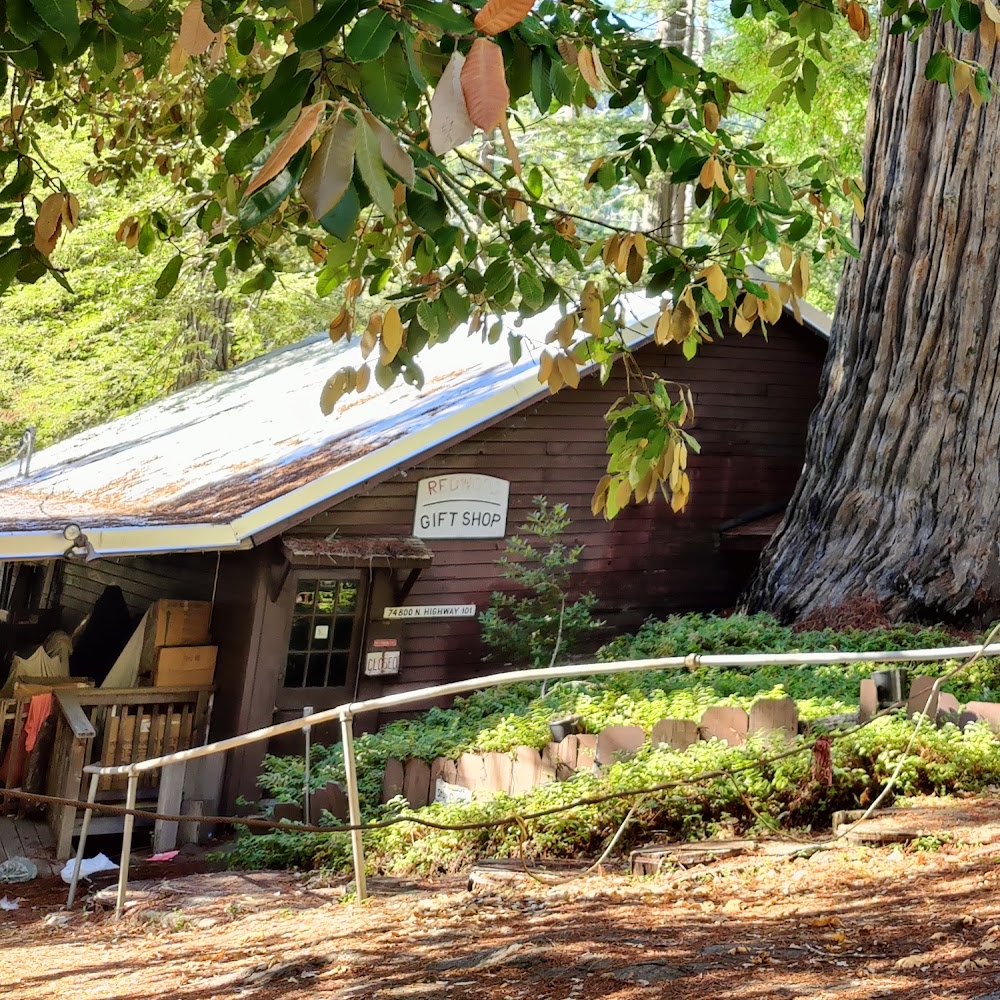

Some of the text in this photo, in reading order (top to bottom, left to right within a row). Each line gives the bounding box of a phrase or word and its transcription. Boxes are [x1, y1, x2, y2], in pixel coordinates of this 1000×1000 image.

[427, 477, 501, 496] REDWO
[420, 511, 502, 529] GIFT SHOP
[387, 608, 414, 617] 74800
[424, 606, 460, 616] HIGHWAY
[462, 606, 473, 615] 101
[367, 656, 398, 671] CLOSED
